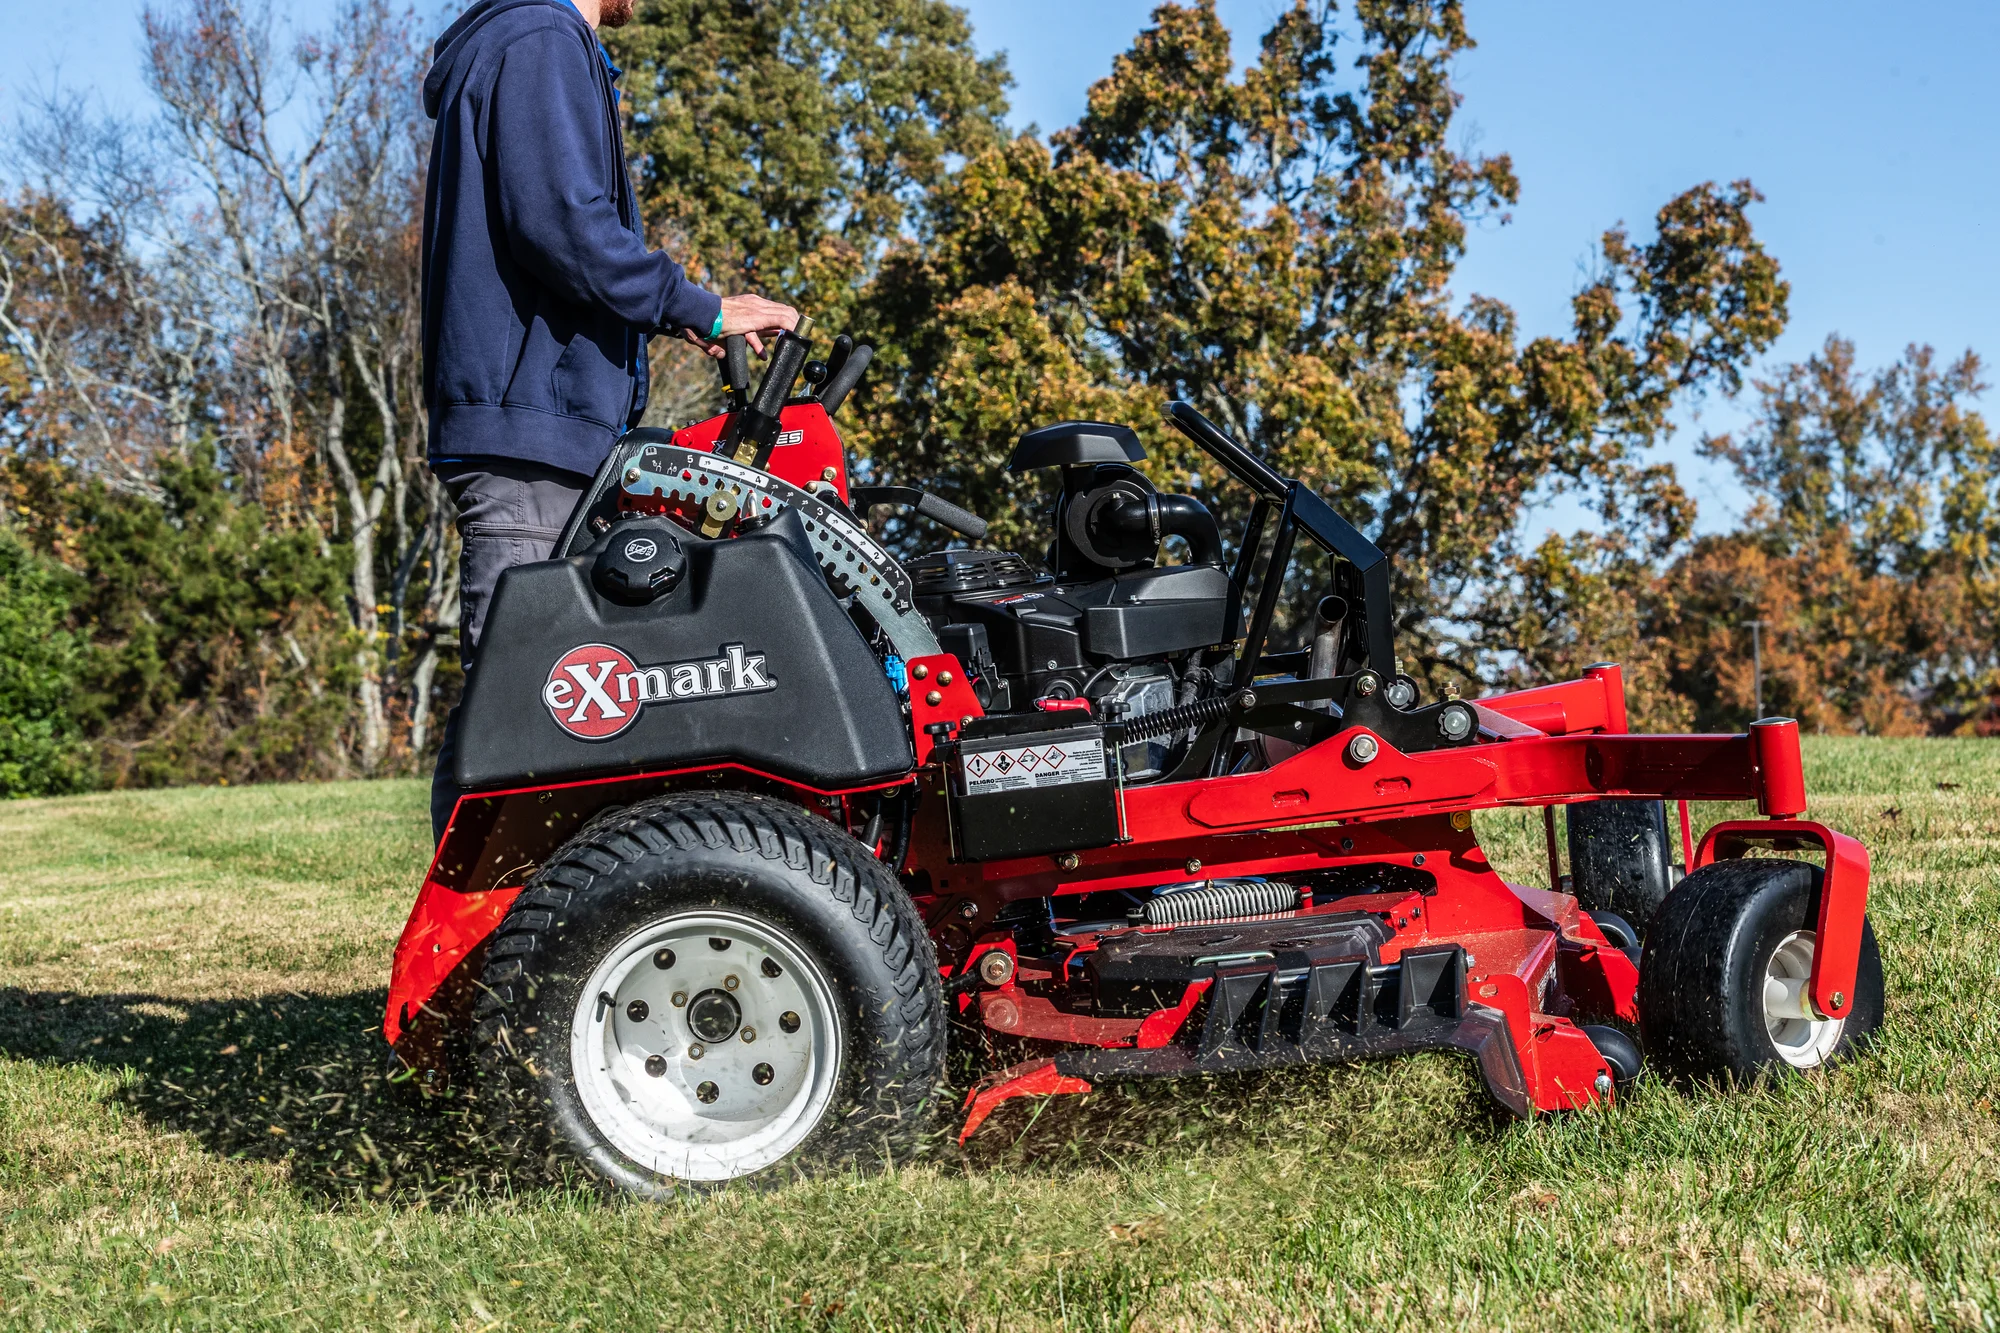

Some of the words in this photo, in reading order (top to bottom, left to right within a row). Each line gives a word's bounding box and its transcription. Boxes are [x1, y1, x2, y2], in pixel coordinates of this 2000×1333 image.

[687, 455, 694, 463] 5
[755, 475, 762, 484] 4
[817, 507, 824, 516] 3
[873, 552, 880, 560] 2
[894, 570, 900, 578] 1
[1035, 770, 1060, 778] DANGER
[969, 778, 995, 786] PELIGRO
